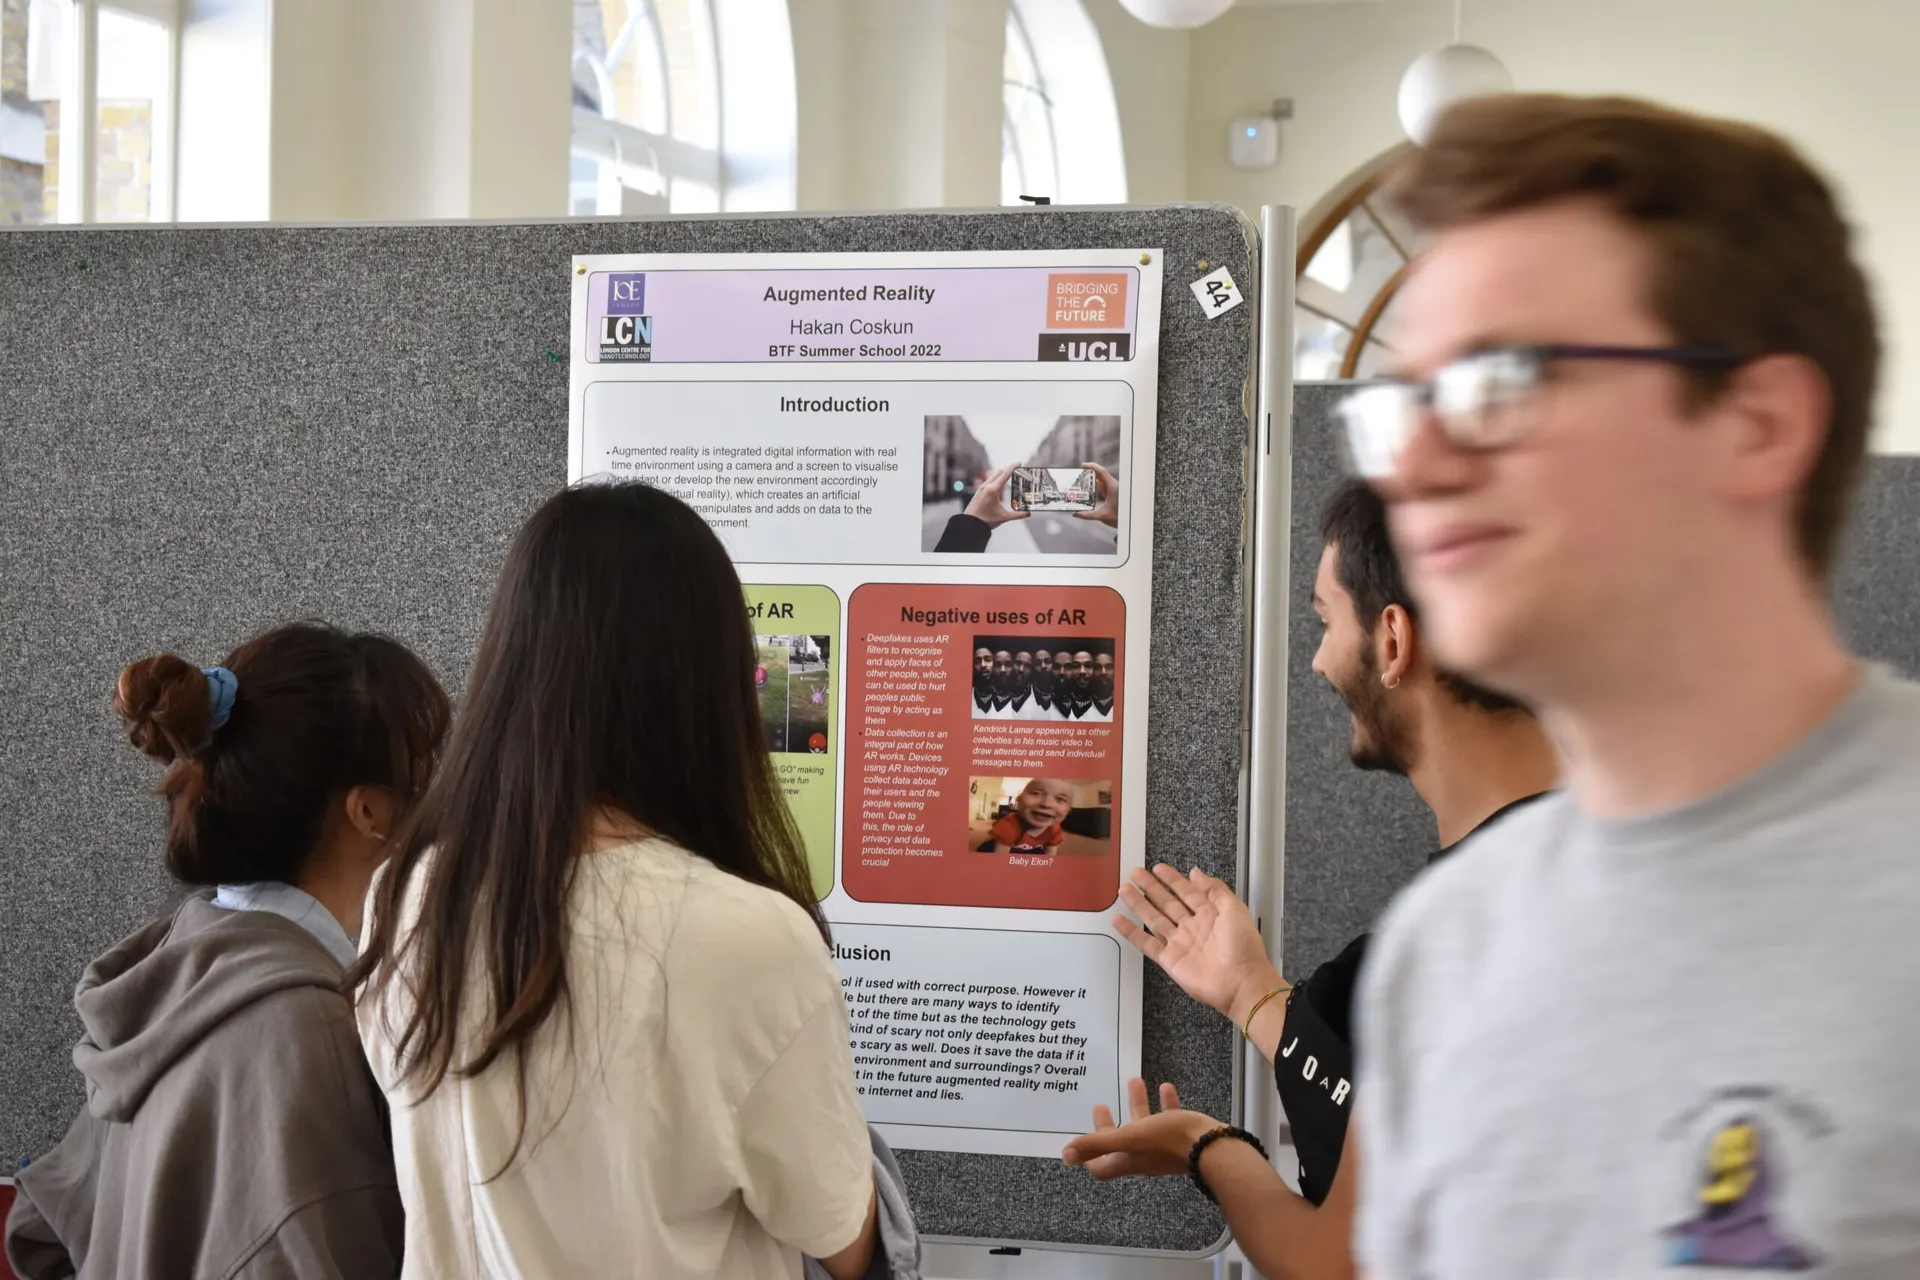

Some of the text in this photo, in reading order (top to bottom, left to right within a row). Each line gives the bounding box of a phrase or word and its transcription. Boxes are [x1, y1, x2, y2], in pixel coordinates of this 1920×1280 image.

[1056, 282, 1119, 295] BRIDGING
[1205, 280, 1231, 309] 44
[763, 285, 936, 306] Augmented Reality
[1056, 296, 1081, 308] THE
[1055, 310, 1107, 322] FUTURE
[600, 316, 653, 345] LCN
[790, 318, 913, 335] Hakan Coskun
[600, 346, 620, 354] LONDON
[769, 344, 942, 357] BTF Summer School 2022
[1067, 341, 1125, 362] UCL
[781, 396, 889, 412] Introduction
[611, 446, 897, 459] Augmented reality is integrated digital information with real
[611, 460, 899, 472] time environment using a camera and a screen to visualise
[661, 476, 672, 485] or
[674, 474, 713, 487] develop
[715, 475, 731, 485] the
[733, 476, 755, 485] new
[756, 475, 819, 486] environment
[820, 475, 879, 488] accordingly
[697, 489, 733, 501] reality),
[735, 489, 764, 499] which
[767, 490, 804, 500] creates
[806, 492, 819, 500] an
[822, 490, 860, 500] artificial
[692, 503, 873, 515] manipulates and adds on data to the
[705, 518, 751, 529] ronment.
[747, 602, 794, 619] of AR
[901, 606, 1086, 627] Negative uses of AR
[867, 633, 950, 644] Deepfakes uses AR
[866, 669, 889, 678] other
[922, 670, 947, 679] which
[864, 727, 948, 739] Data collection is an
[973, 724, 1111, 737] Kendrick Lamar appearing as other
[864, 751, 878, 760] AR
[908, 752, 942, 762] Devices
[864, 763, 949, 776] using AR technology
[972, 759, 1012, 768] messages
[1013, 759, 1022, 767] to
[861, 846, 944, 857] protection becomes
[1008, 856, 1054, 867] Baby Elon?
[854, 977, 1087, 999] if used with correct purpose. However it
[856, 992, 1061, 1015] but there are many ways to identify
[857, 1008, 870, 1019] of
[872, 1009, 890, 1020] the
[893, 1010, 918, 1021] time
[921, 1011, 941, 1023] but
[943, 1015, 957, 1023] as
[960, 1013, 979, 1025] the
[982, 1015, 1048, 1031] technology
[1050, 1019, 1076, 1031] gets
[849, 1023, 1088, 1048] kind of scary not only deepfakes but they
[860, 1041, 892, 1053] scary
[894, 1043, 908, 1052] as
[911, 1042, 937, 1053] well.
[940, 1043, 971, 1055] Does
[973, 1045, 982, 1056] it
[984, 1048, 1012, 1057] save
[1015, 1047, 1034, 1058] the
[1037, 1048, 1063, 1060] data
[1065, 1050, 1075, 1060] if
[1077, 1050, 1085, 1061] it
[854, 1055, 1087, 1076] environment and surroundings? Overall
[862, 1070, 873, 1080] in
[877, 1070, 895, 1082] the
[898, 1071, 932, 1084] future
[935, 1076, 1001, 1088] augmented
[1004, 1078, 1041, 1092] reality
[1044, 1080, 1078, 1093] might
[868, 1085, 913, 1098] internet
[915, 1089, 938, 1099] and
[940, 1089, 964, 1101] lies.
